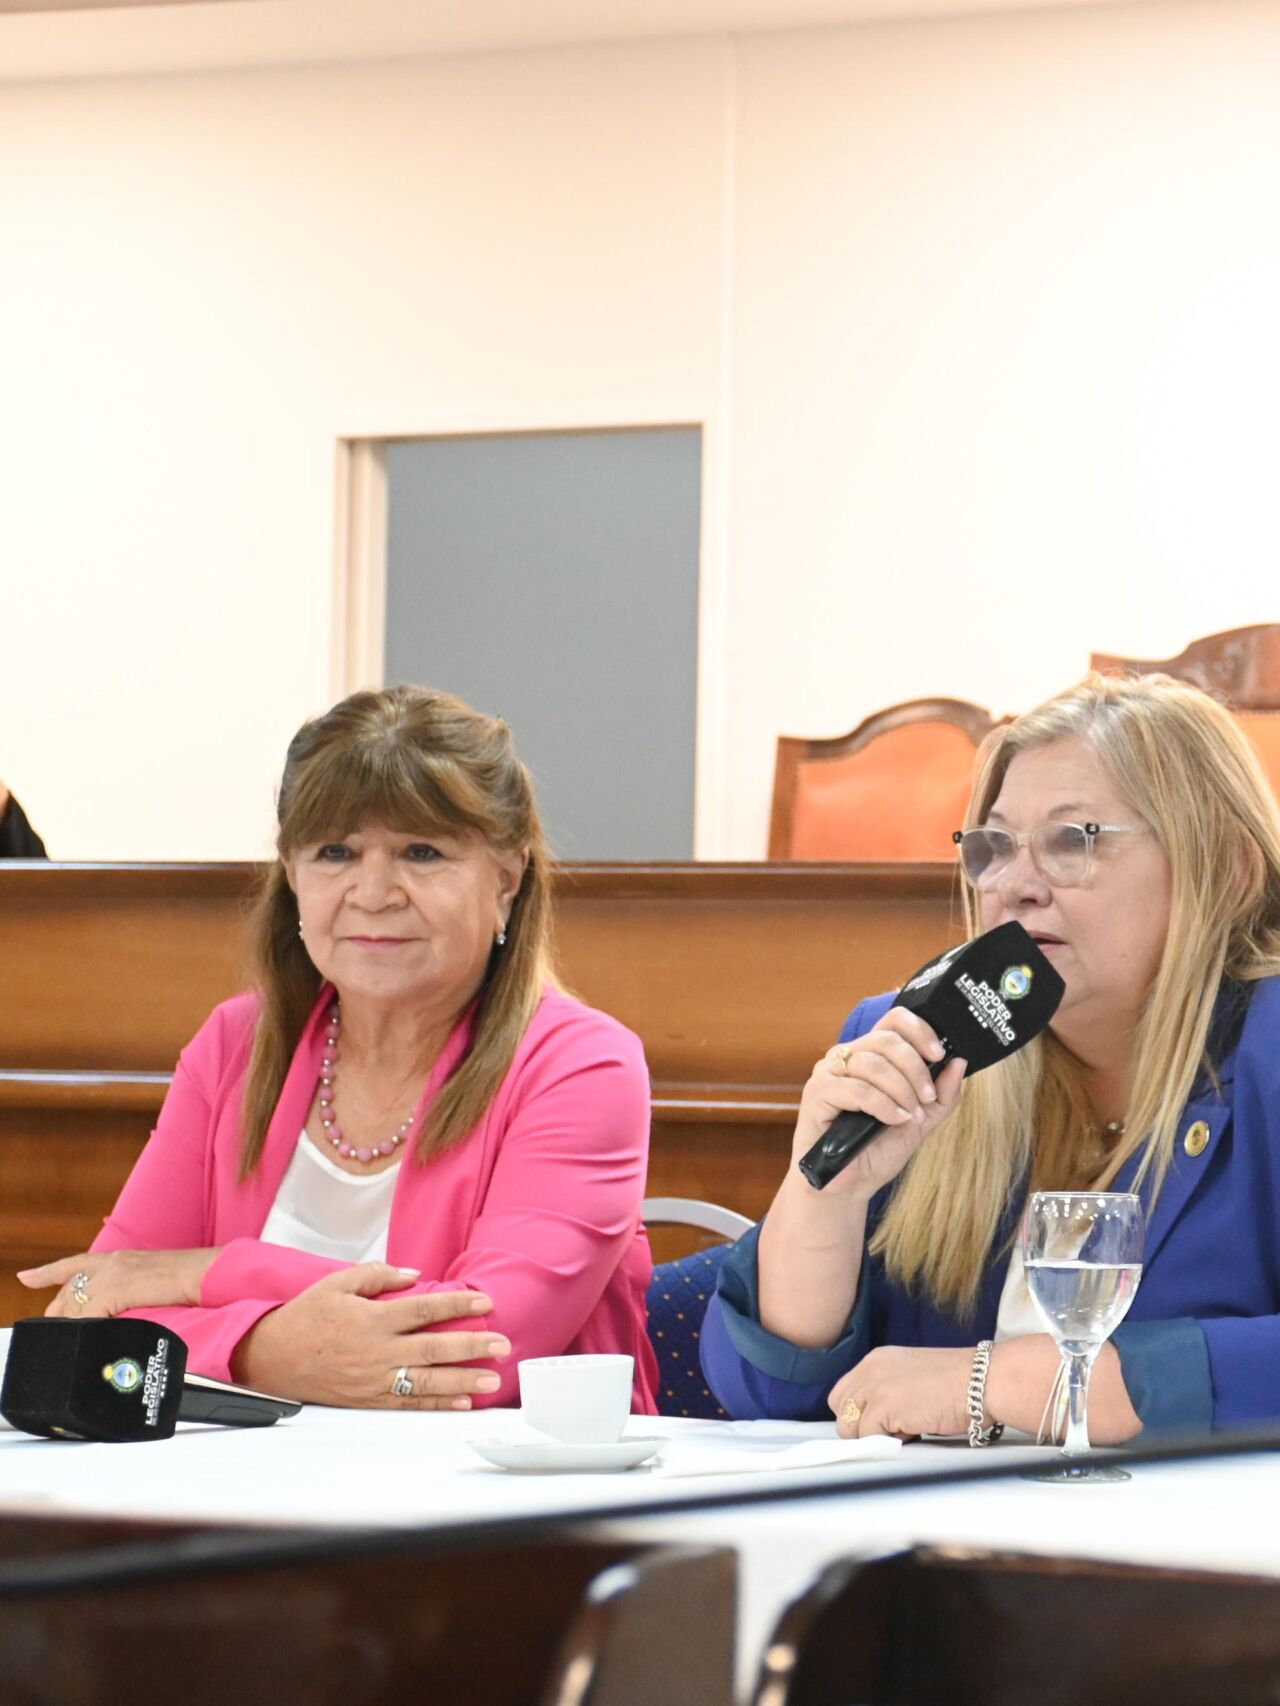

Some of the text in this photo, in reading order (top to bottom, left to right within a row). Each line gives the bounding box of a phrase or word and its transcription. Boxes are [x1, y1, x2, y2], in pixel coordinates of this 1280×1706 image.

[960, 973, 1015, 1041] LEGISLATIVO
[978, 981, 1011, 1021] PODER
[142, 1355, 156, 1405] PODER
[145, 1338, 164, 1425] LEGISLATIVO
